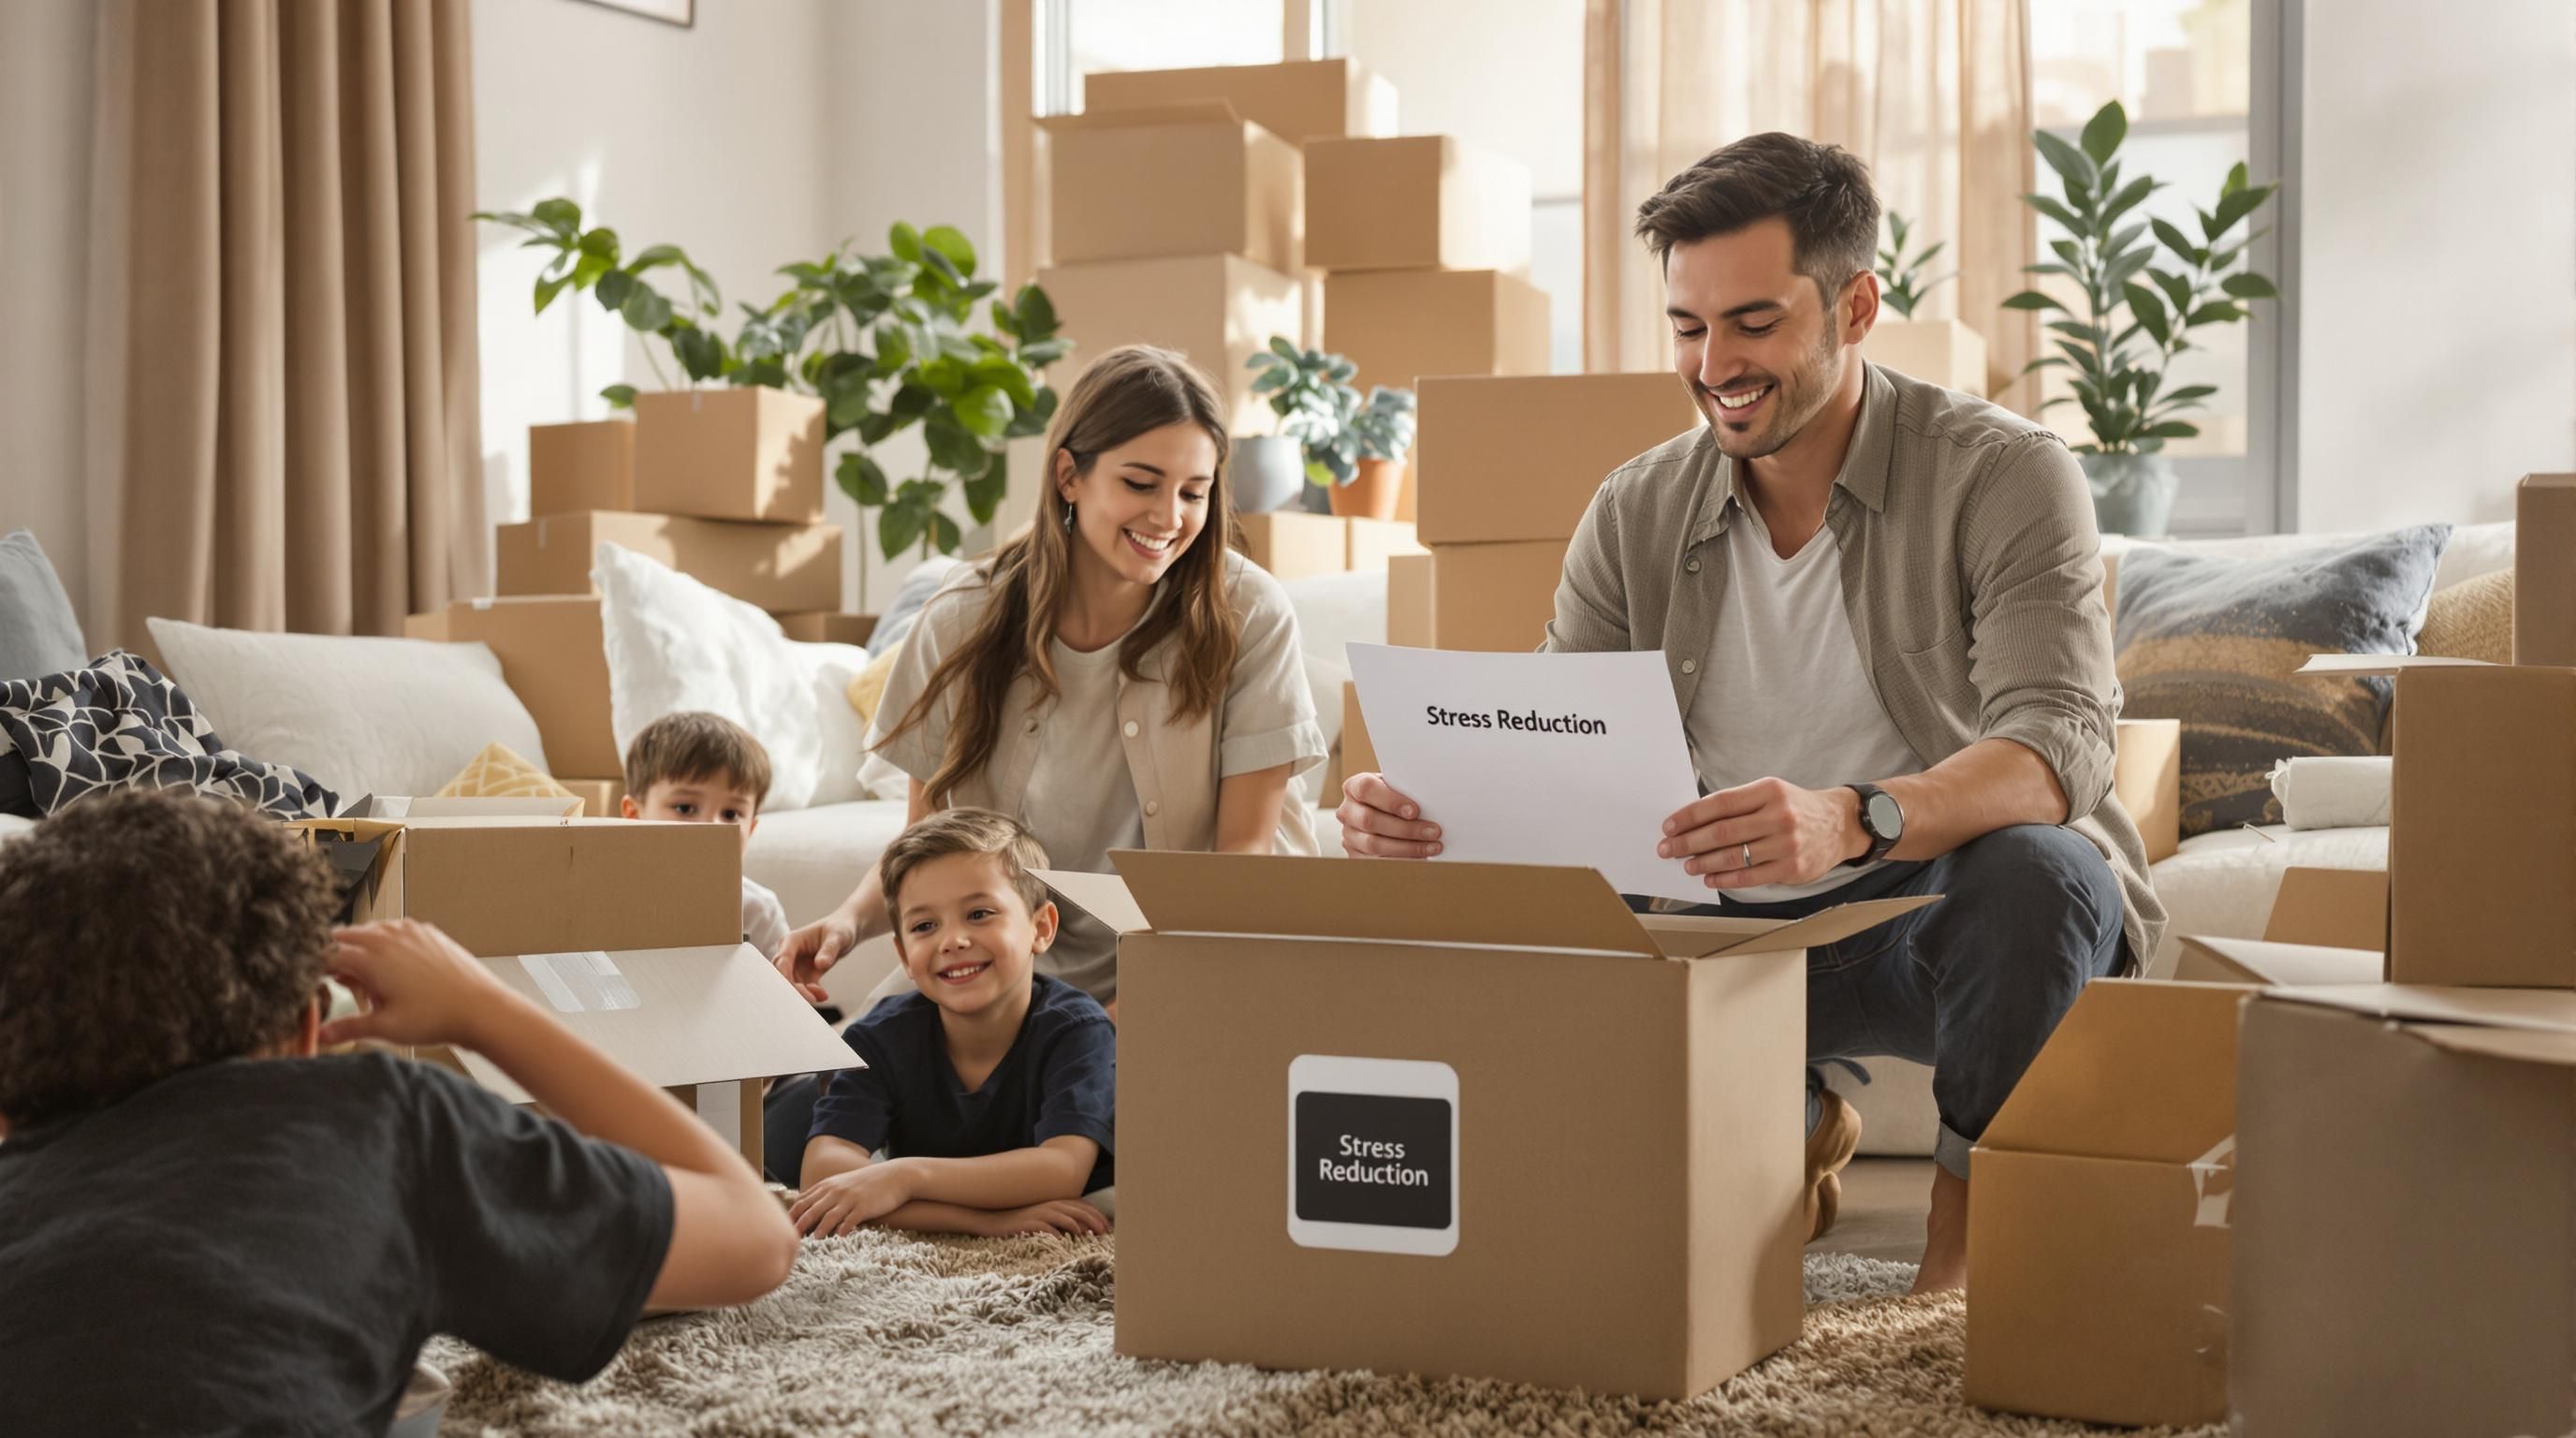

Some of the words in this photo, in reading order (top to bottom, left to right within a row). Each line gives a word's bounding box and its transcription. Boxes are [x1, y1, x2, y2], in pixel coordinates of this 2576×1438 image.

[1426, 705, 1493, 729] Stress
[1496, 709, 1607, 735] Reduction
[1339, 1134, 1405, 1159] Stress
[1319, 1158, 1428, 1186] Reduction
